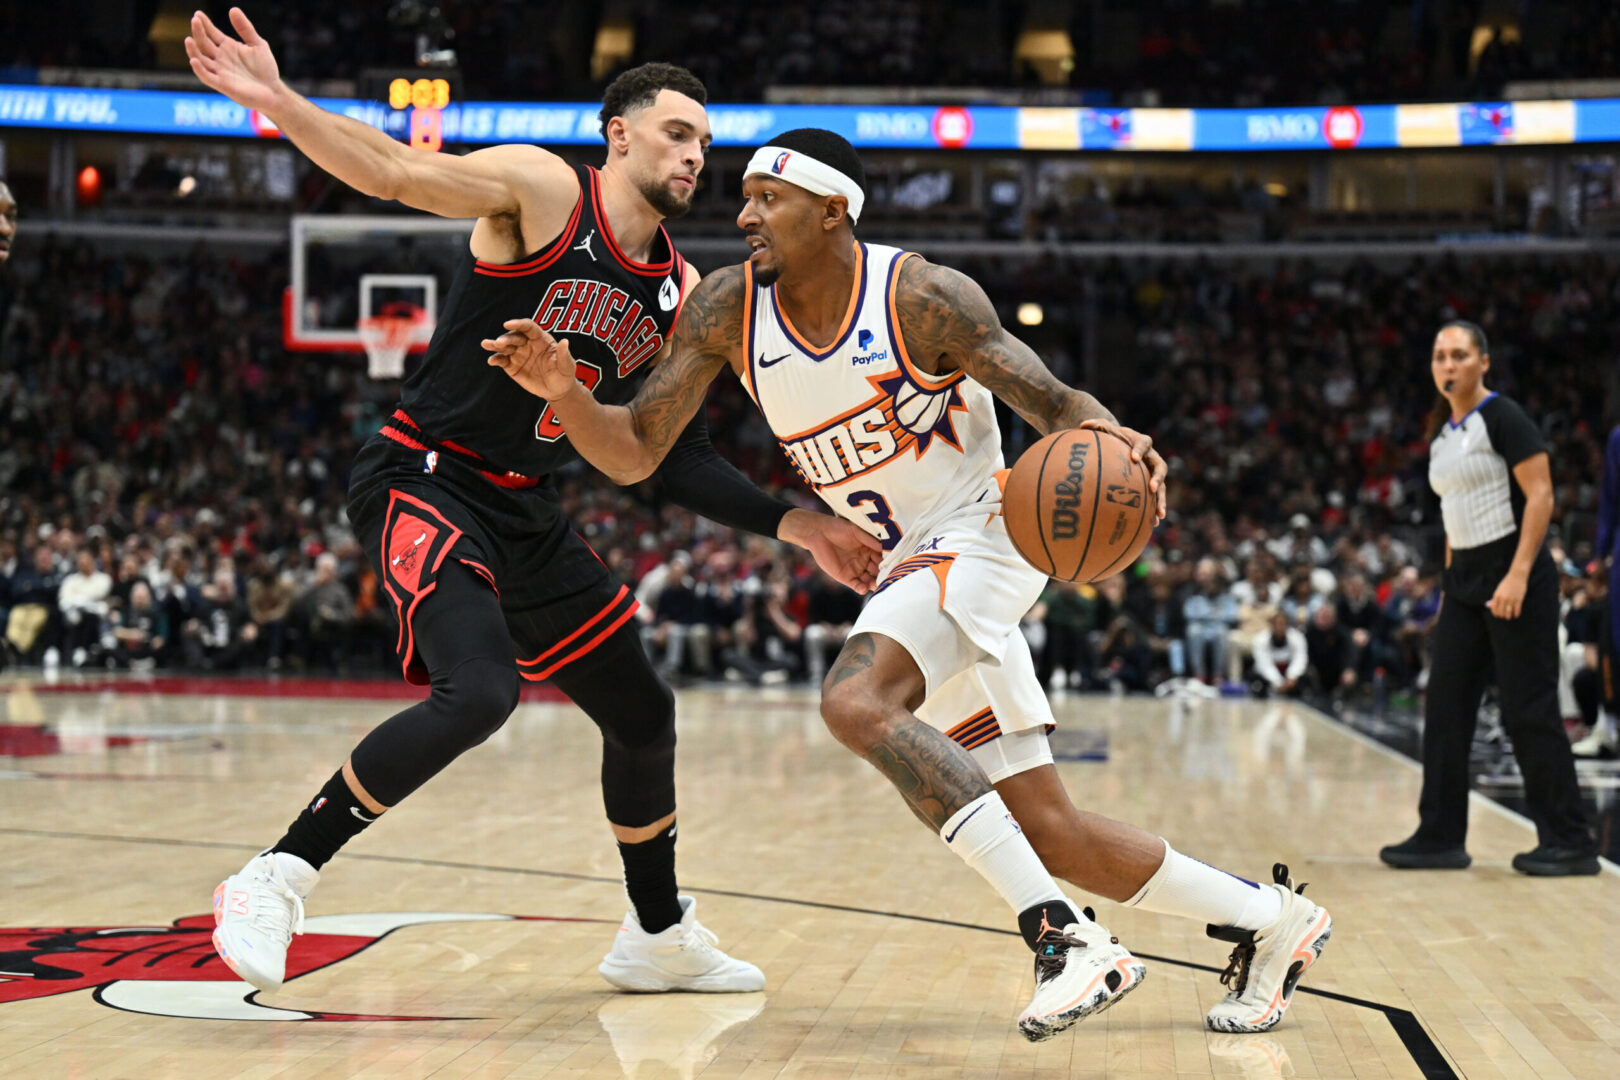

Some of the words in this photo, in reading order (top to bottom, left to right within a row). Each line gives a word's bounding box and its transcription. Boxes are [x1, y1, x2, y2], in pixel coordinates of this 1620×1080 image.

[856, 111, 928, 140] BMO
[1246, 114, 1318, 142] BMO
[531, 278, 664, 379] CHICAGO
[851, 349, 888, 367] PayPal
[1052, 442, 1091, 542] Wilson
[847, 489, 905, 554] 3
